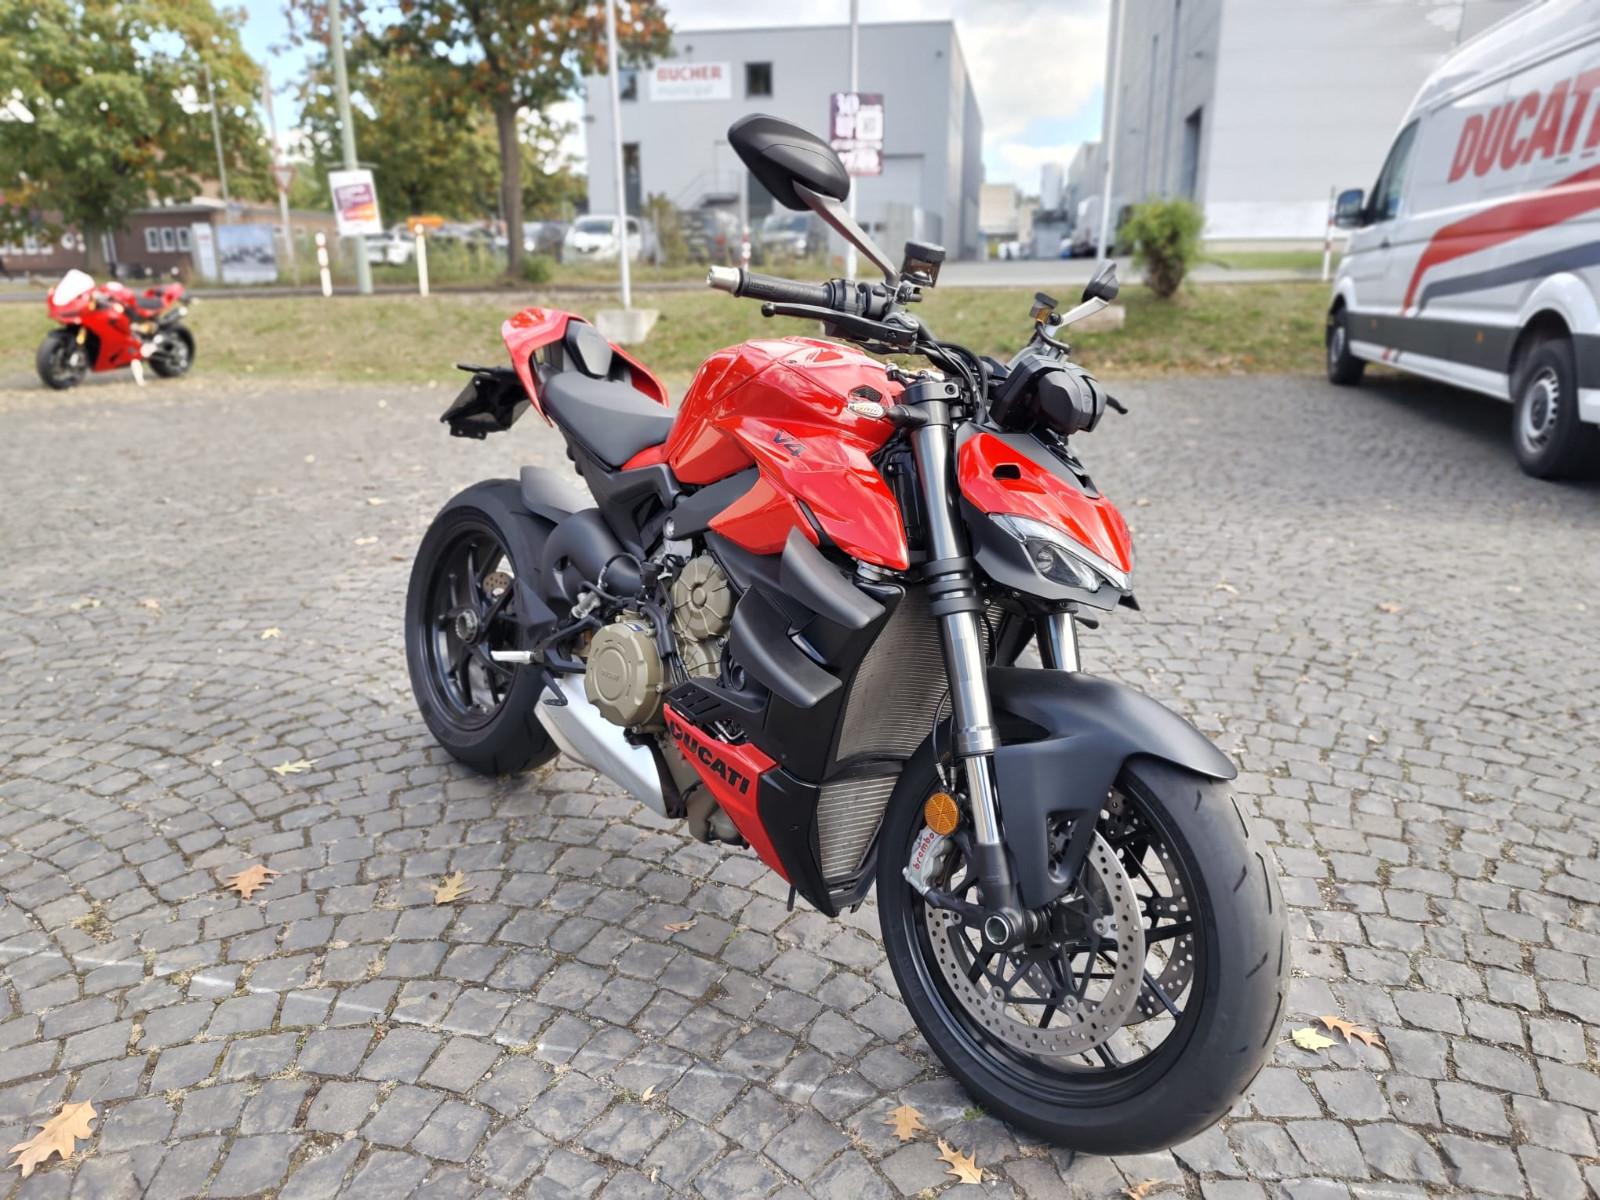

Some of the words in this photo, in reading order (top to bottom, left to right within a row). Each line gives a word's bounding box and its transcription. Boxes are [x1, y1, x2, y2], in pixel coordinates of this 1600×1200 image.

[1447, 66, 1600, 183] DUCAT
[773, 428, 806, 456] V4
[668, 720, 750, 795] DUCATI
[913, 832, 935, 870] brembo
